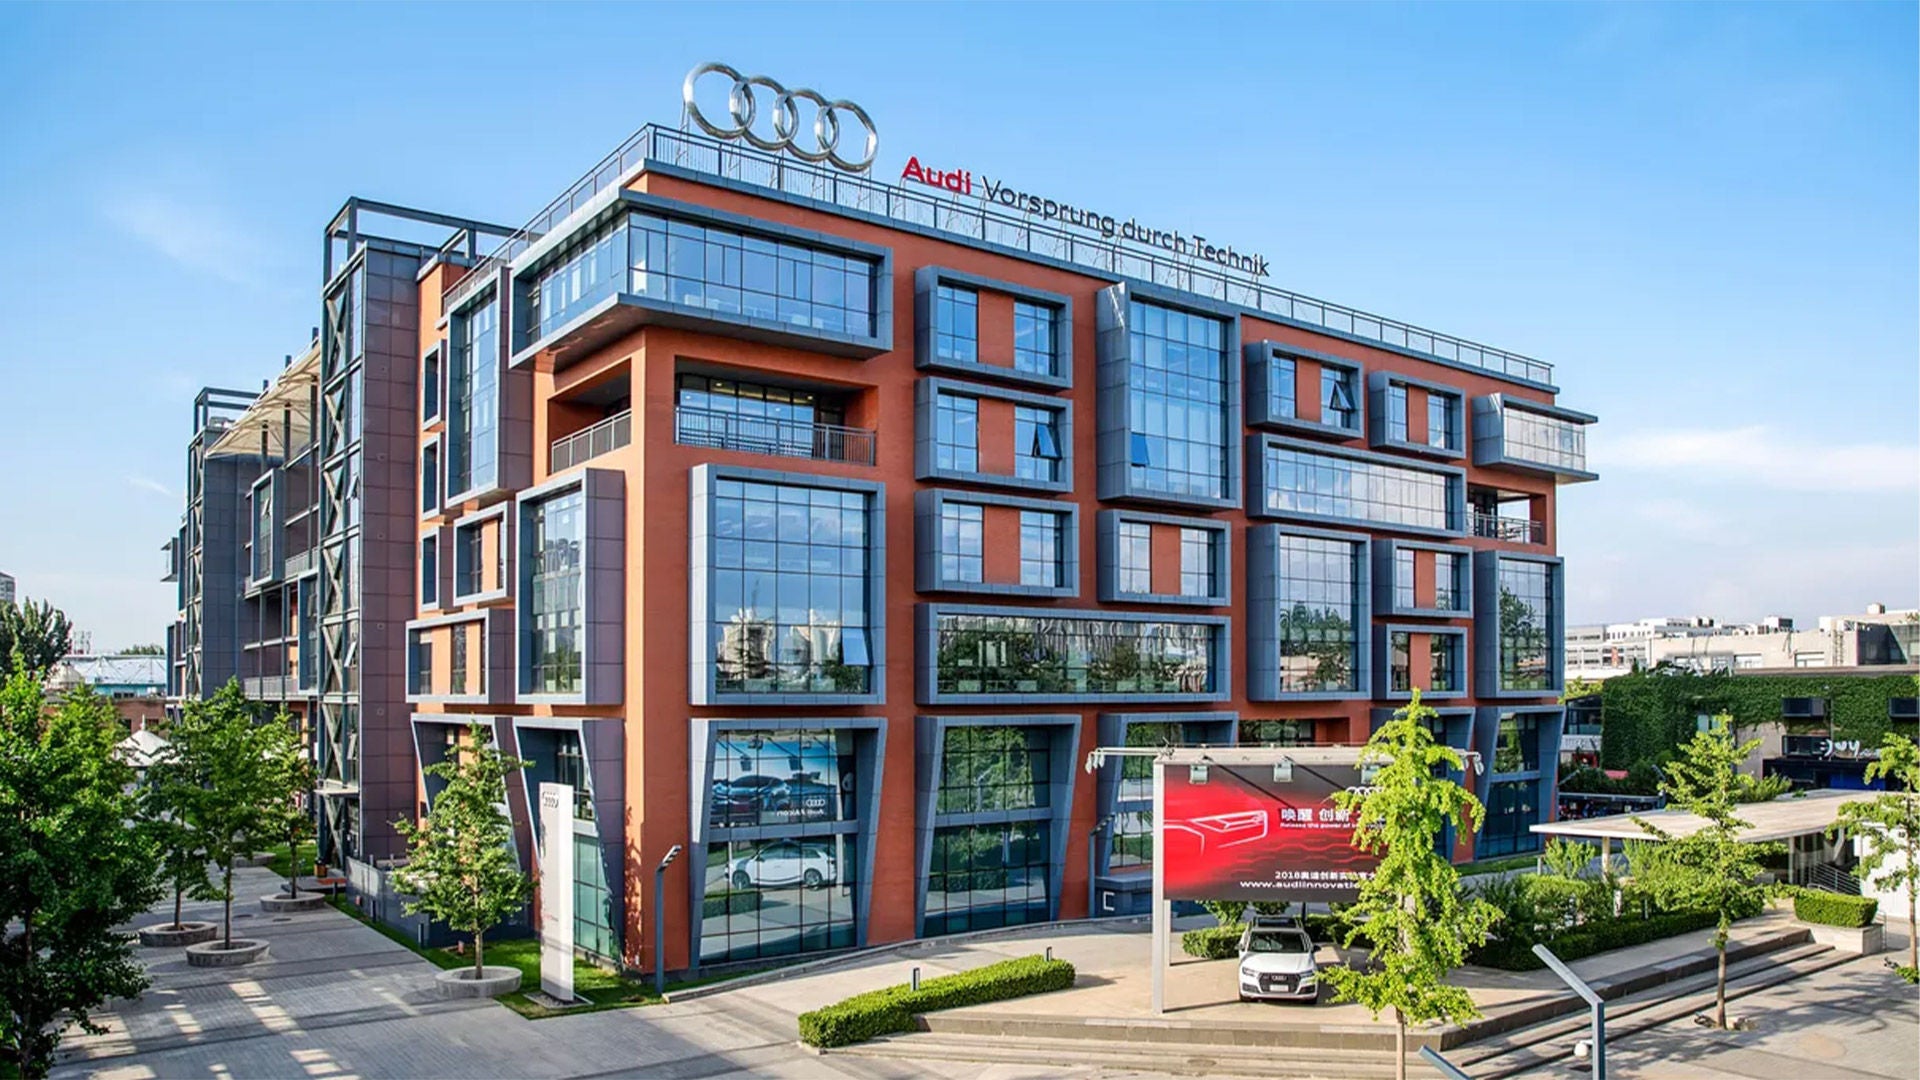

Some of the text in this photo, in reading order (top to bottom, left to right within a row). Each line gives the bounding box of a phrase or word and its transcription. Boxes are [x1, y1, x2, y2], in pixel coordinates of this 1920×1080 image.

[902, 156, 1270, 277] Audi Vorsprung durch Technik
[1240, 881, 1361, 889] www.audiinnovatio
